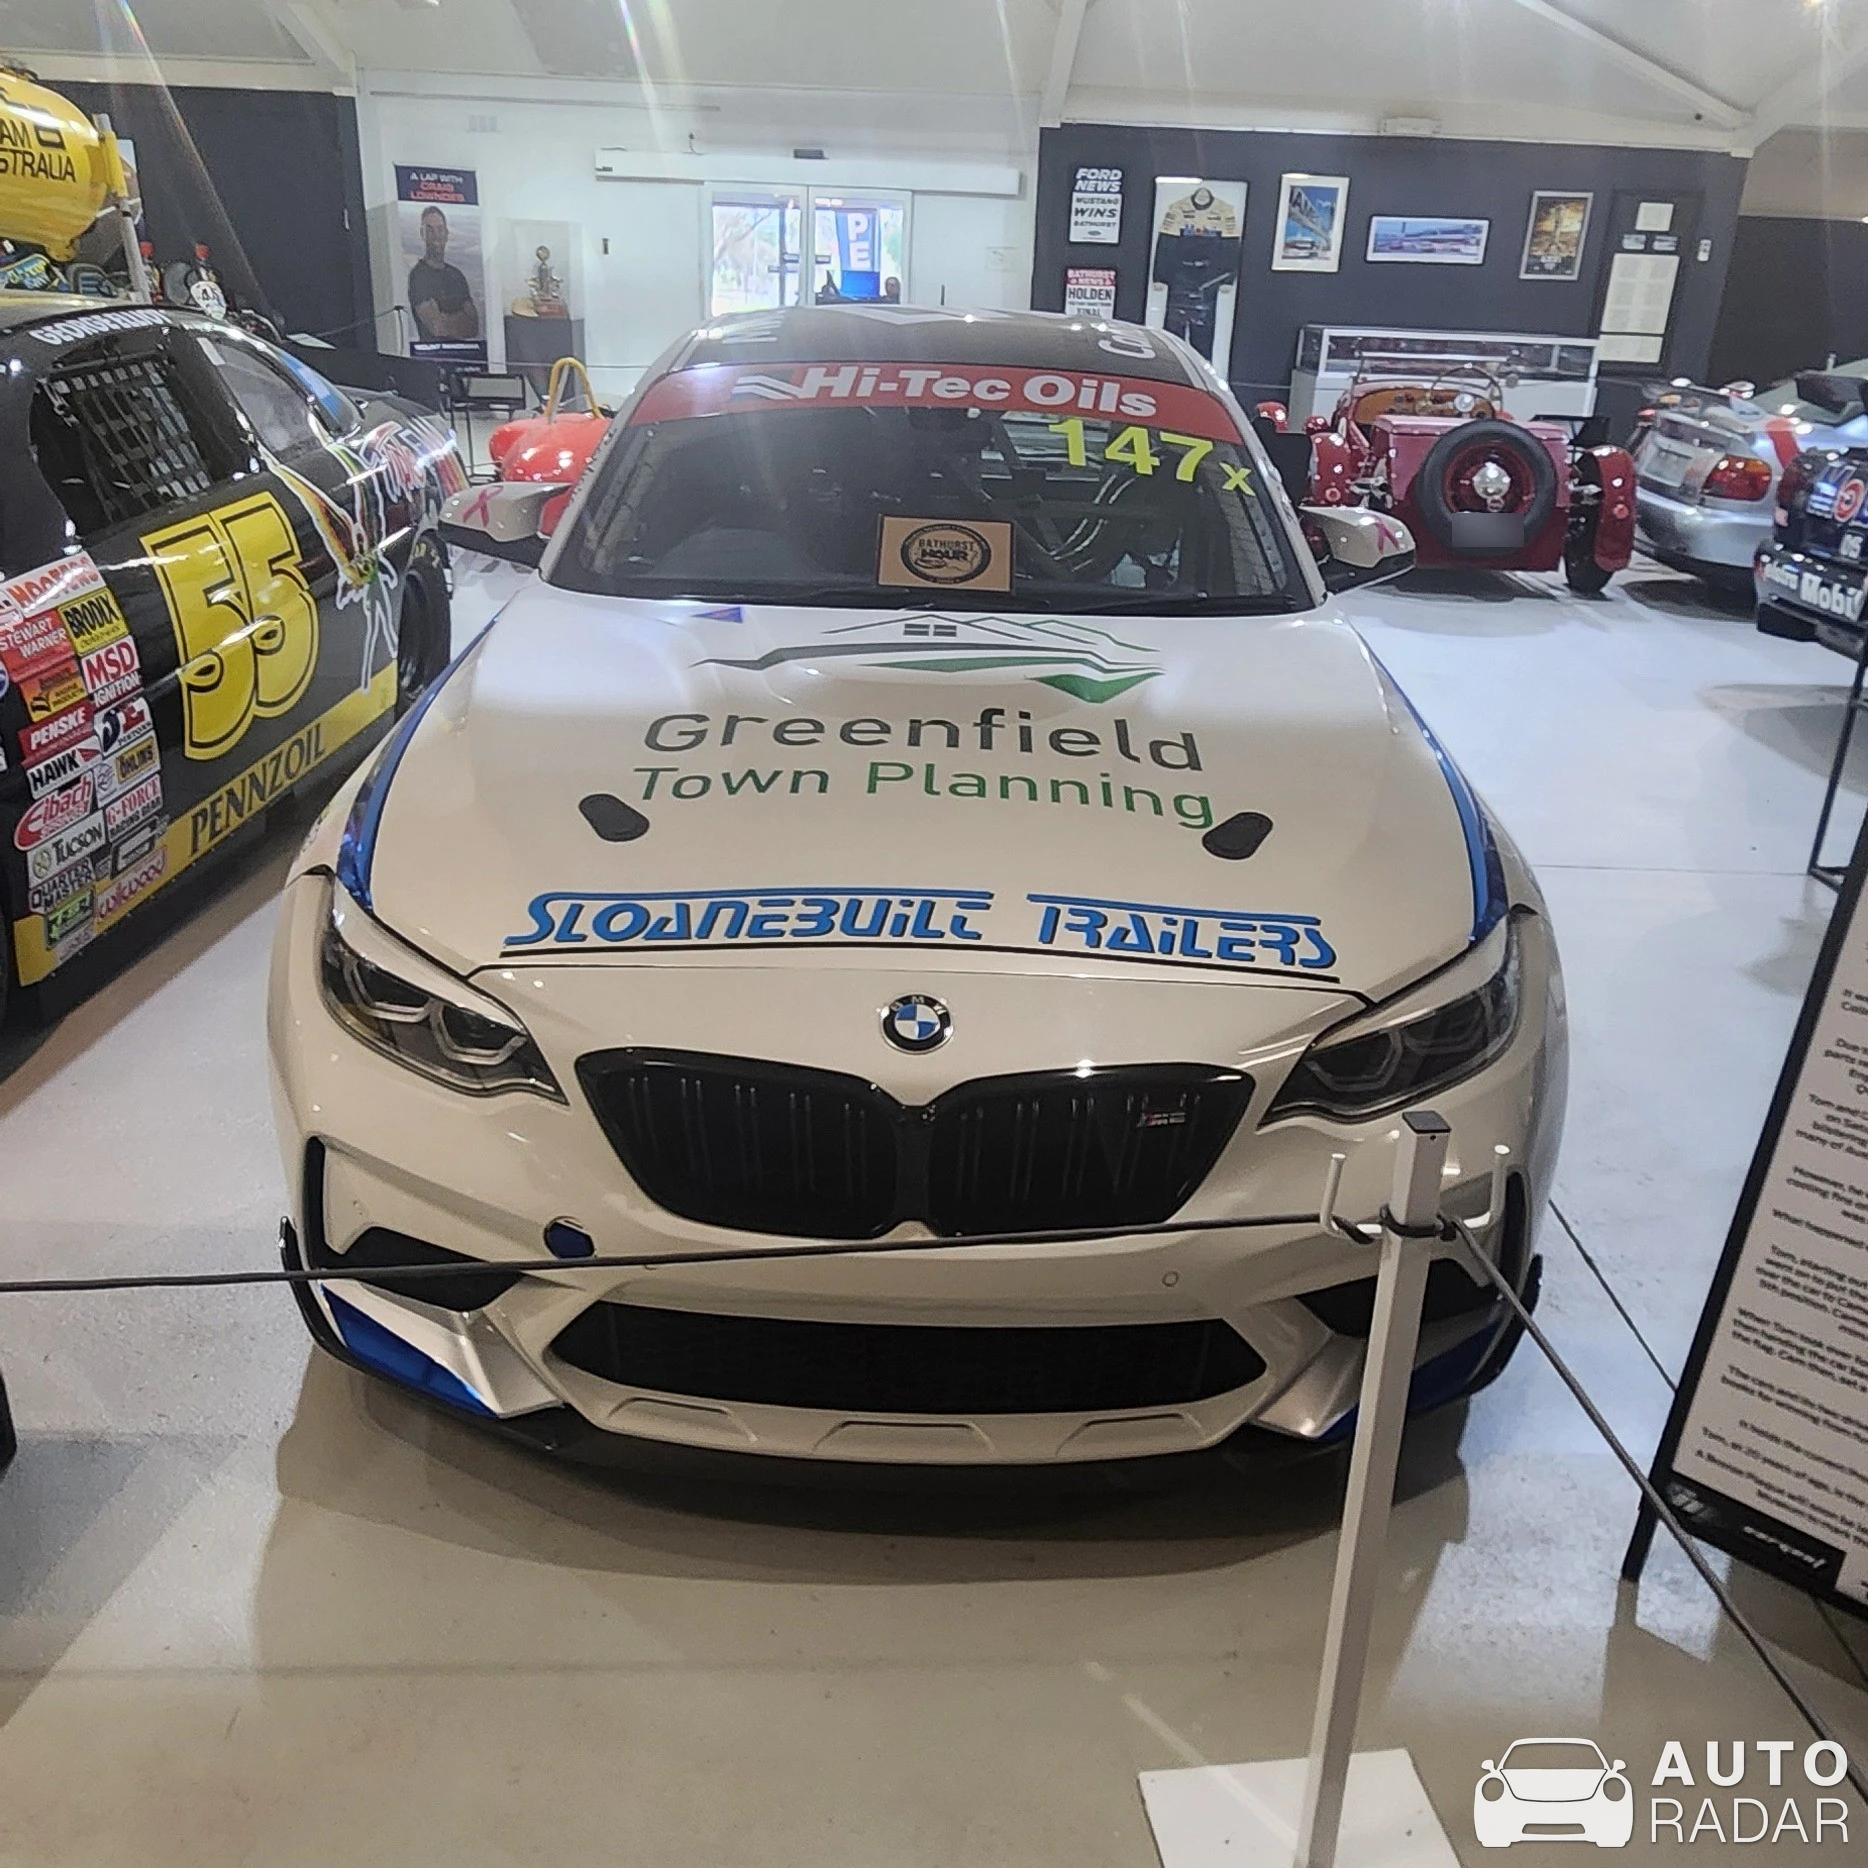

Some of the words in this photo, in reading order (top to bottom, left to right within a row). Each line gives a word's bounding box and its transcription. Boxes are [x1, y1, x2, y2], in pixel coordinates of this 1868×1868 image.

[1074, 180, 1122, 192] NEWS
[1075, 168, 1123, 180] FORD
[1074, 207, 1117, 218] WINS
[1068, 287, 1112, 300] HOLDEN
[800, 366, 1012, 401] Hi-Tec
[1022, 374, 1157, 418] Oils
[1048, 418, 1213, 483] 147
[919, 539, 975, 551] BATHURST
[63, 593, 120, 639] BRODIX
[1801, 571, 1863, 623] Mobil
[0, 617, 53, 651] STEWART
[18, 627, 67, 659] WARNER
[140, 490, 319, 761] 55
[85, 641, 136, 691] MSD
[92, 671, 141, 708] IGNITION
[30, 707, 86, 750] PENSKE
[644, 707, 1203, 771] Greenfield
[29, 750, 80, 792] HAWK
[190, 722, 325, 857] PENNZOIL
[106, 776, 160, 826] G-FORCE
[633, 766, 829, 801] Town
[866, 761, 1214, 829] Planning
[890, 996, 948, 1015] BMW
